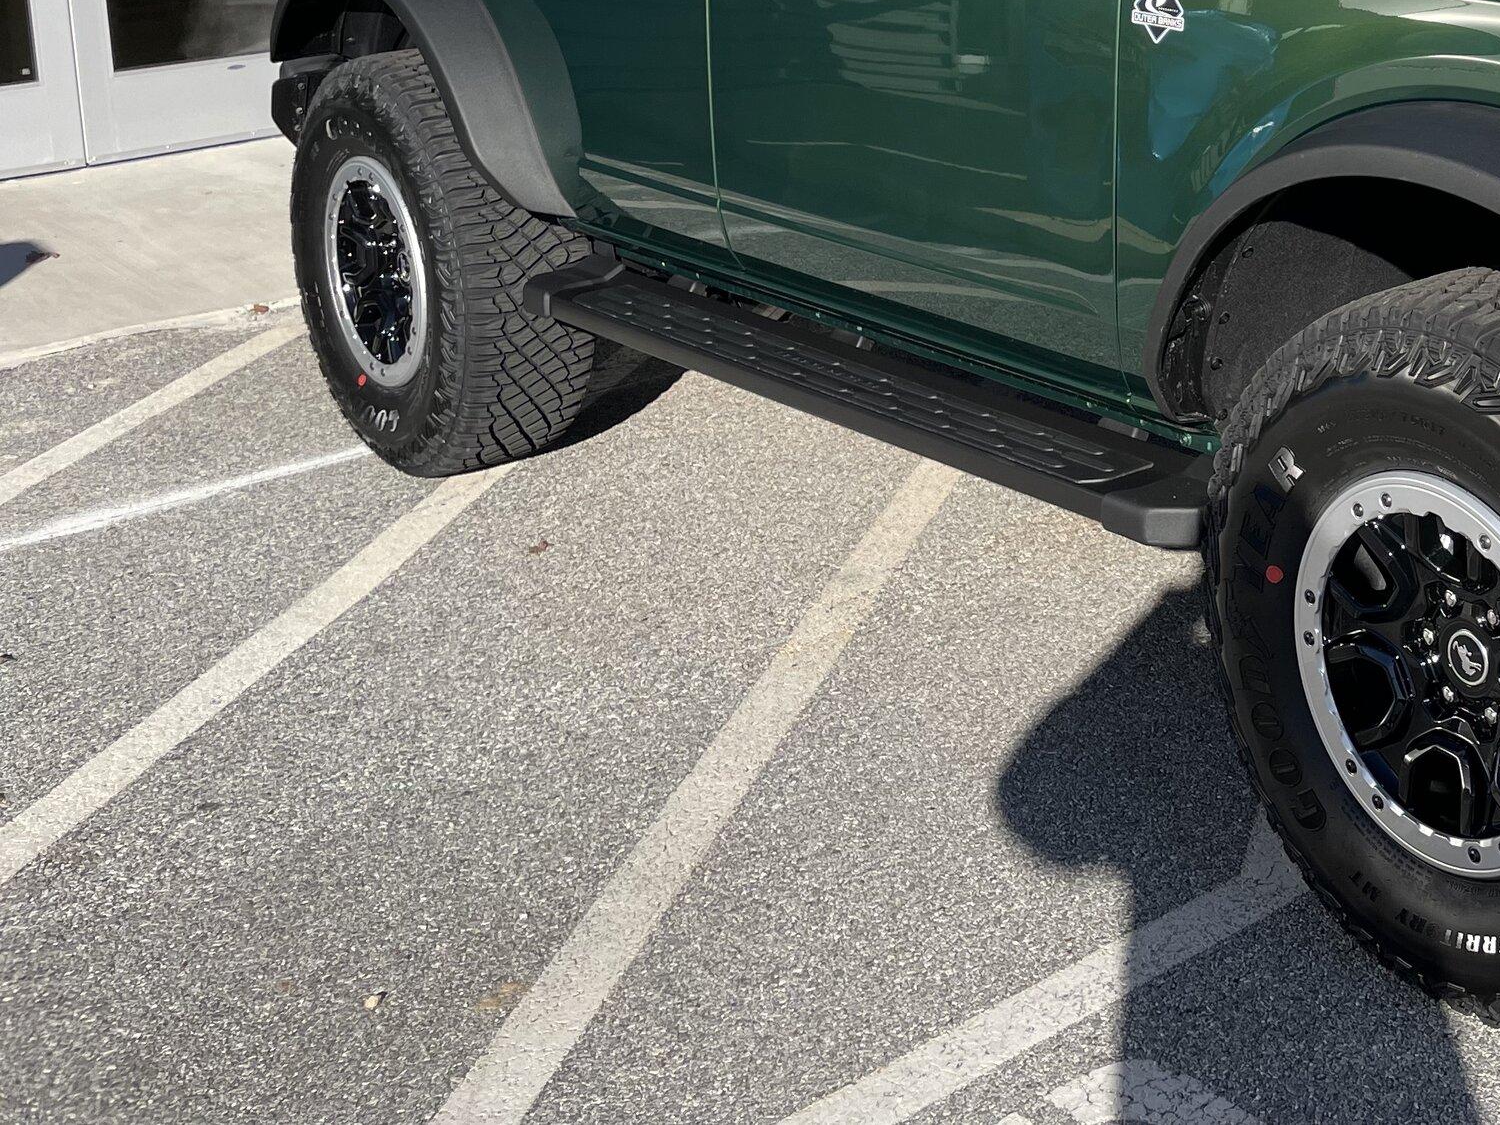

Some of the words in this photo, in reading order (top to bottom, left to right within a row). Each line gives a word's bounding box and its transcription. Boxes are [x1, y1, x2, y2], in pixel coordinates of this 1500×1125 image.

[1134, 12, 1157, 24] OUTER
[1158, 15, 1182, 28] BANKS
[1232, 445, 1327, 835] GOODYEAR
